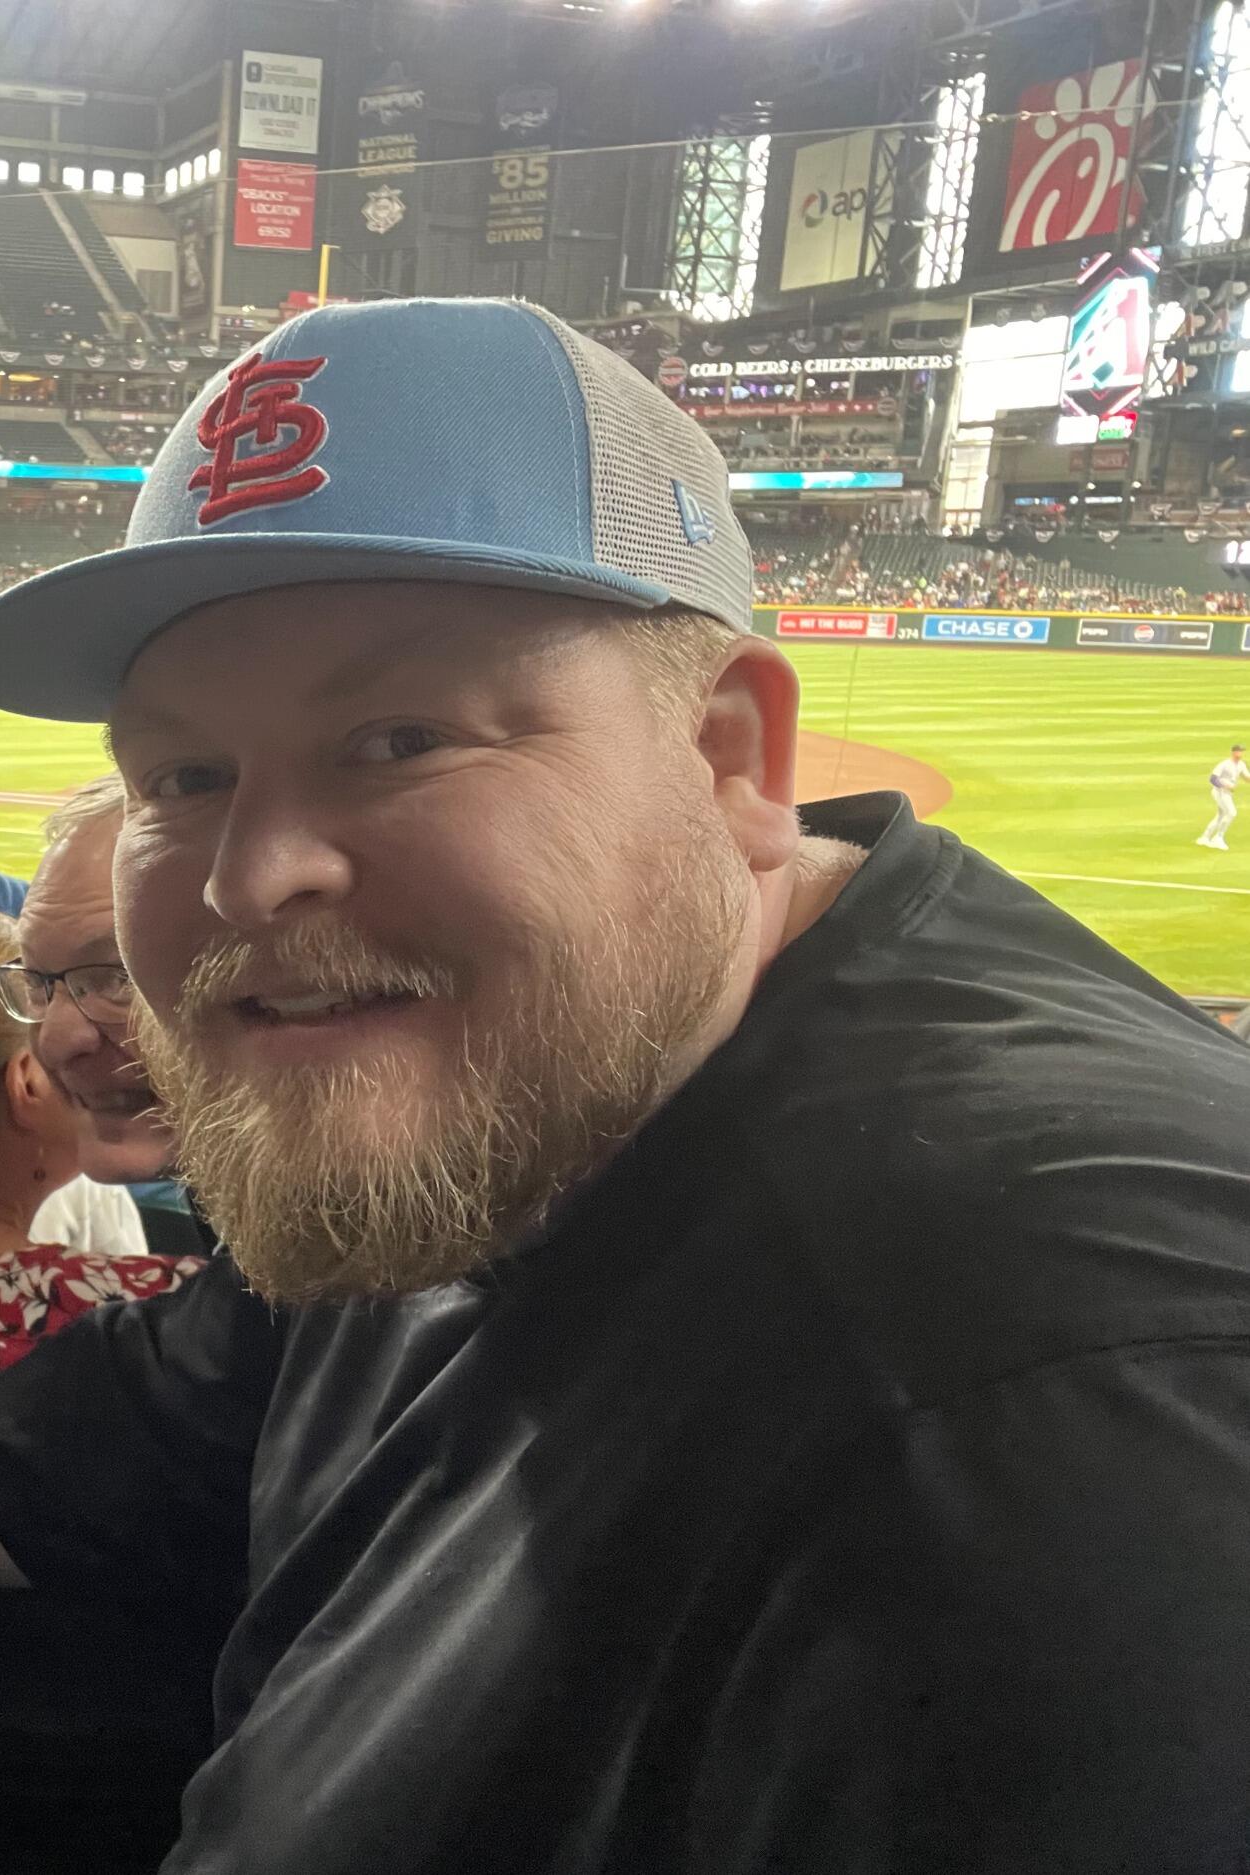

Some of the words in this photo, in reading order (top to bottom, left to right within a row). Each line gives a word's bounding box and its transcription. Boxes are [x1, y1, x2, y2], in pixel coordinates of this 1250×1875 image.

[358, 145, 416, 164] LEAGUE
[486, 226, 544, 244] GIVING
[690, 363, 733, 377] COLD
[735, 360, 790, 376] BEERS
[790, 360, 802, 374] &
[804, 354, 954, 373] CHEESEBURGERS
[937, 620, 1011, 636] CHASE
